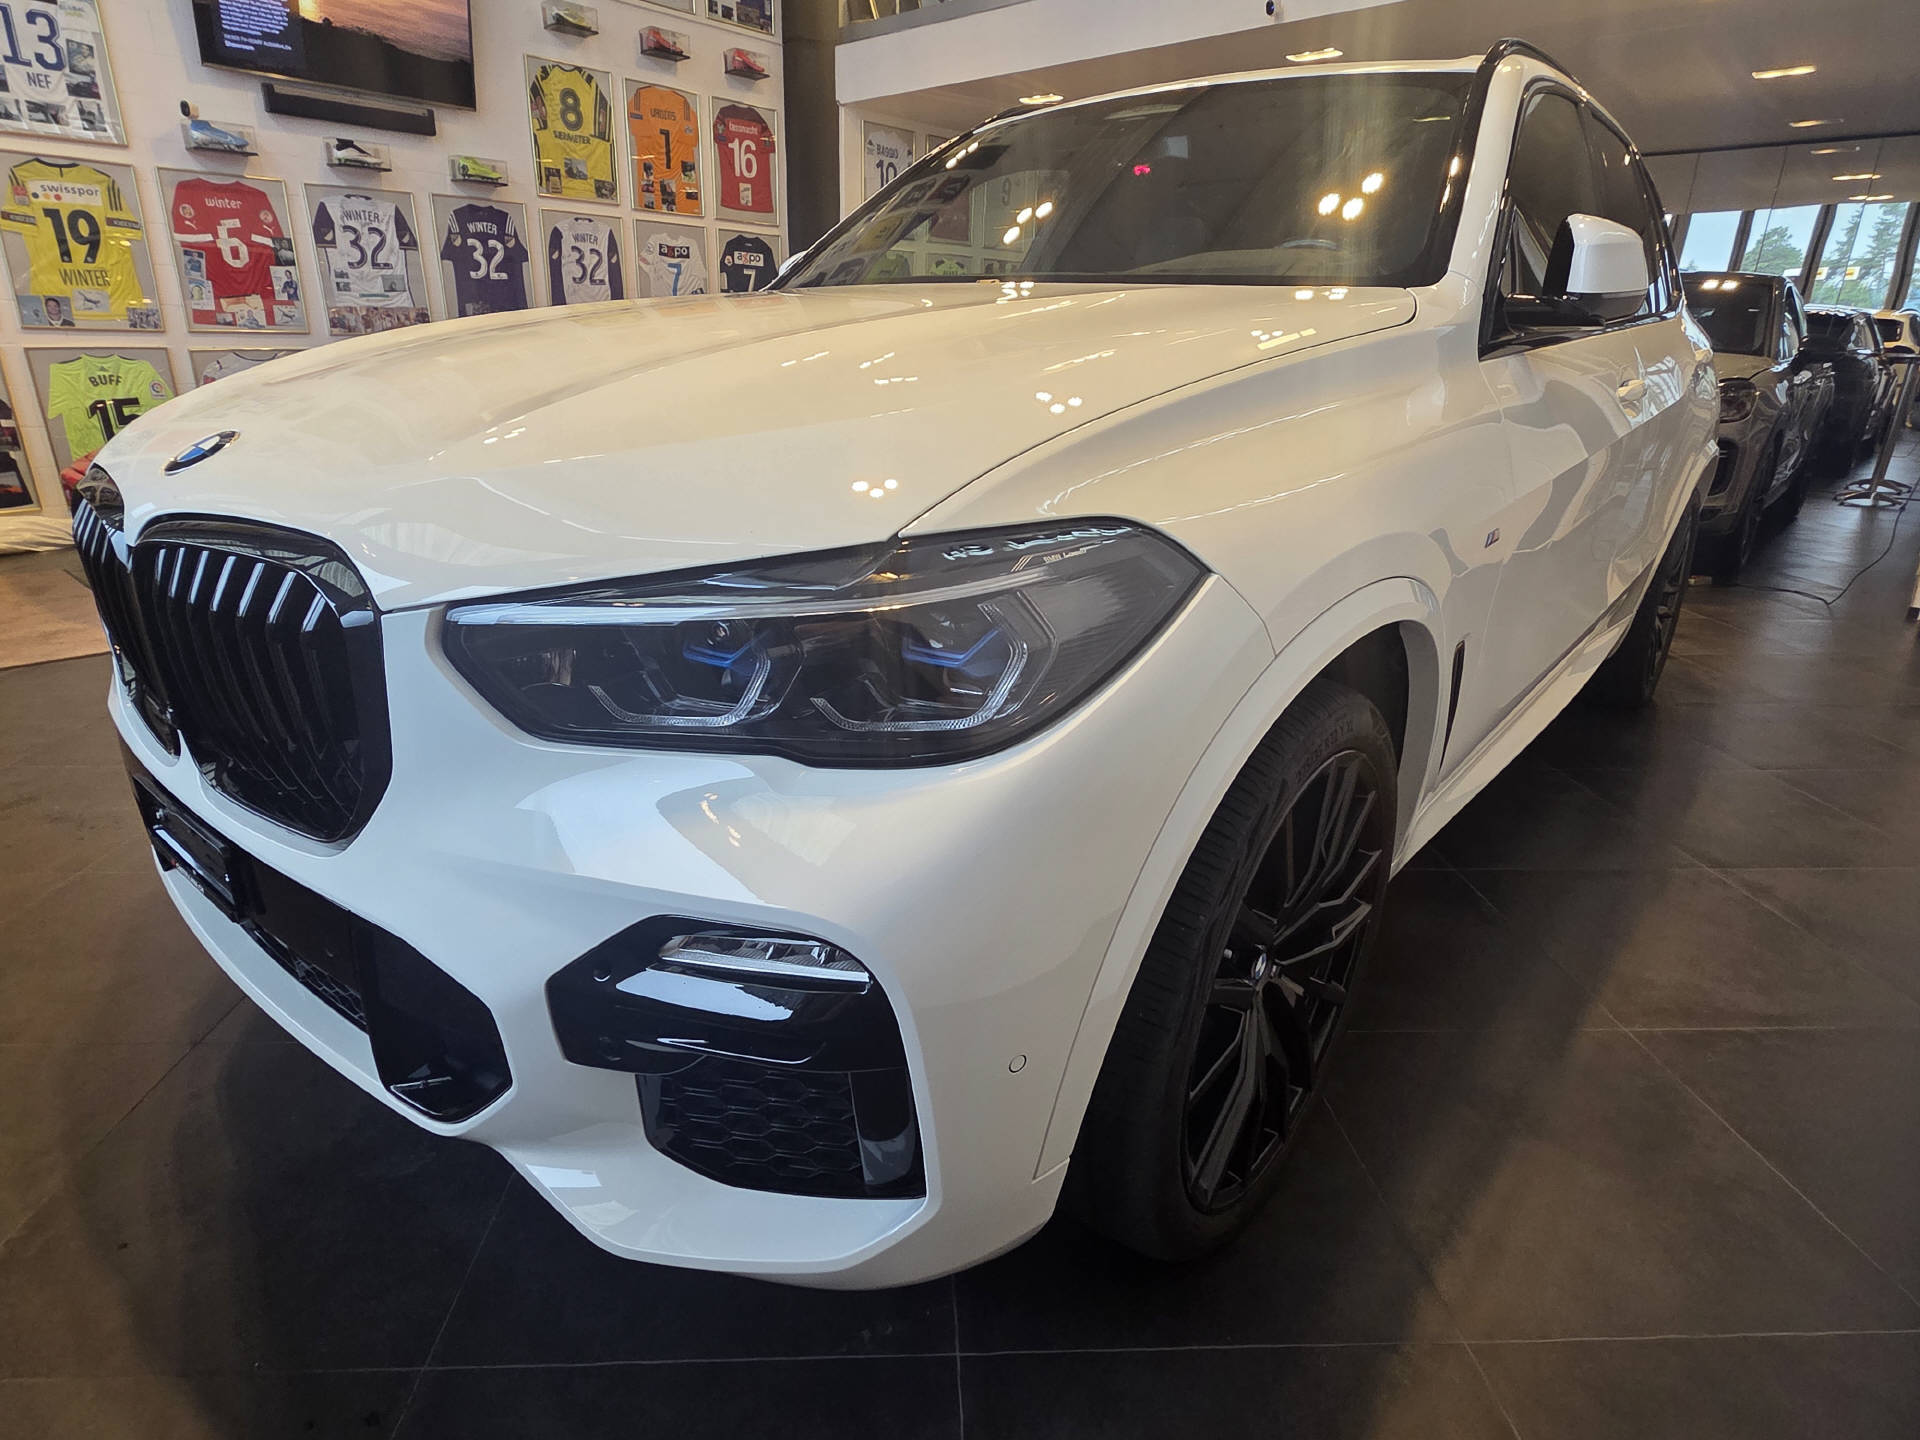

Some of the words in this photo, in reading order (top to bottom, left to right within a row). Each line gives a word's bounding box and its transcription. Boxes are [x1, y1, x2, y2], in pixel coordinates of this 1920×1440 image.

[0, 3, 66, 71] 13
[26, 71, 52, 89] NEF
[560, 87, 583, 131] 8
[659, 128, 672, 170] 1
[728, 138, 758, 179] 16
[40, 184, 99, 197] swisspor
[204, 197, 243, 209] winter
[342, 209, 380, 222] WINTER
[466, 222, 498, 235] WINTER
[42, 207, 101, 264] 19
[216, 218, 250, 268] 6
[340, 225, 394, 269] 32
[571, 232, 599, 245] WINTER
[467, 238, 509, 280] 32
[571, 246, 606, 286] 32
[58, 268, 111, 288] WINTER
[667, 262, 682, 296] 7
[743, 269, 756, 292] 7
[88, 373, 122, 388] BUFF
